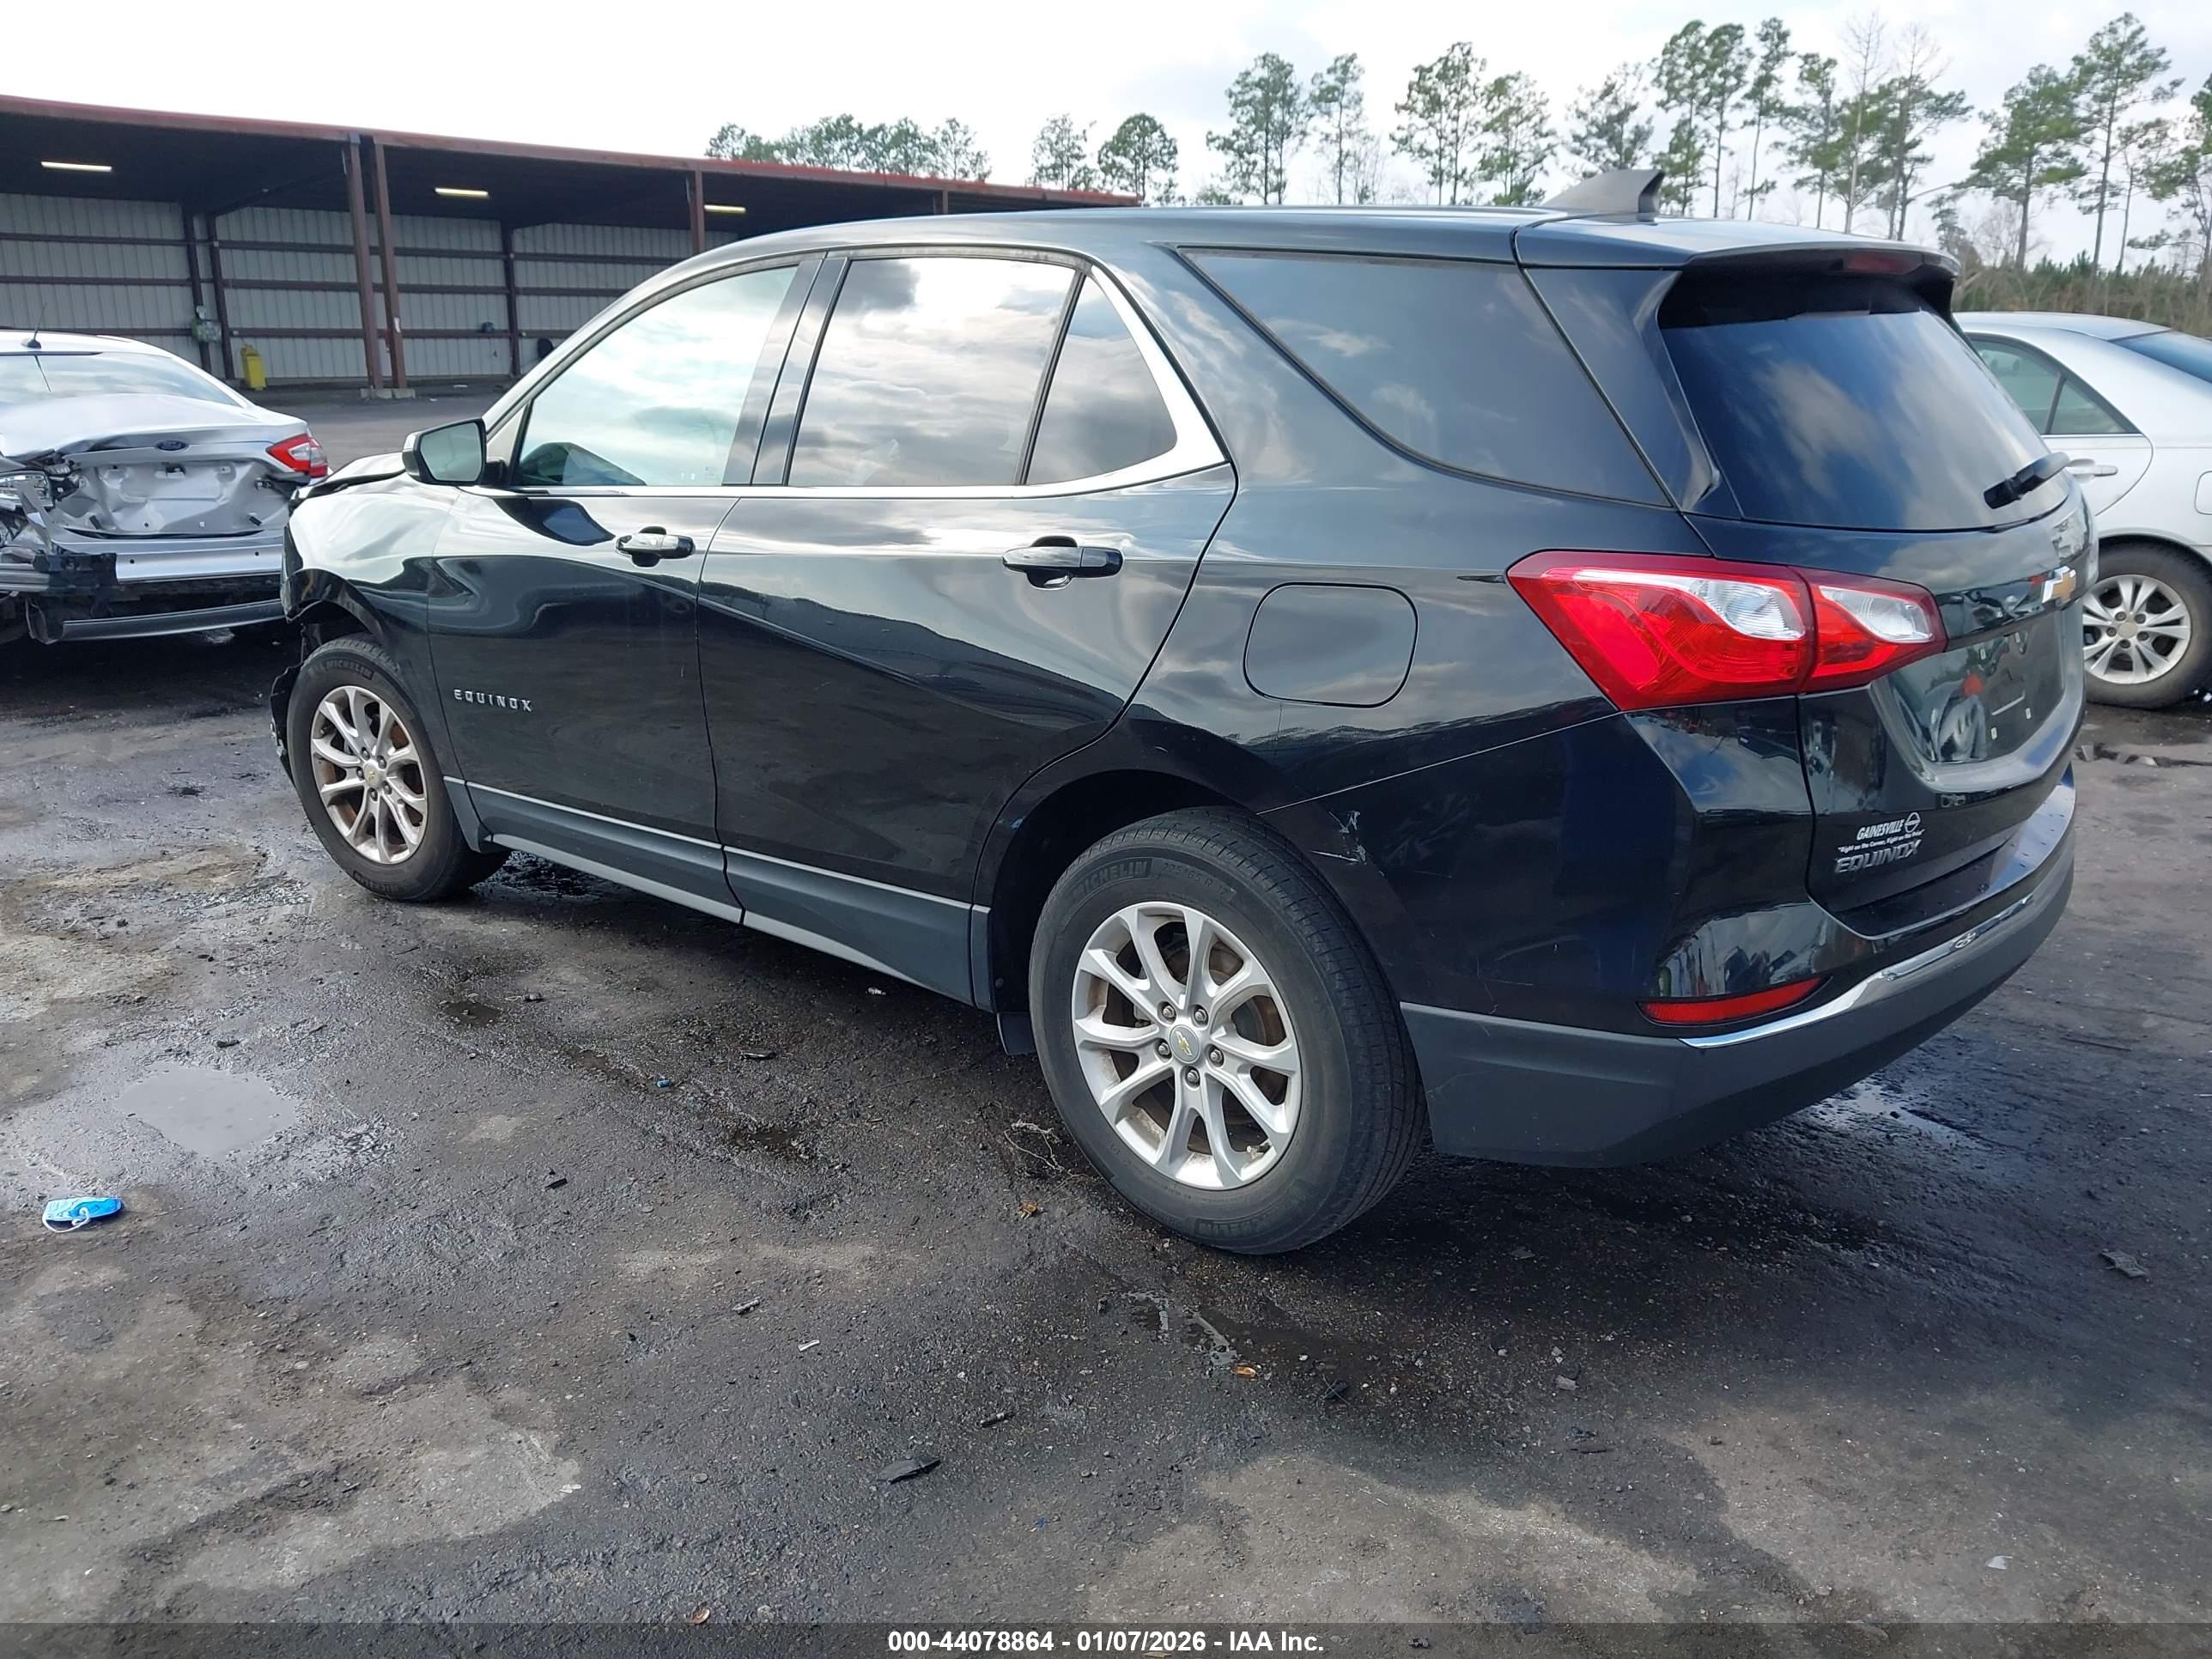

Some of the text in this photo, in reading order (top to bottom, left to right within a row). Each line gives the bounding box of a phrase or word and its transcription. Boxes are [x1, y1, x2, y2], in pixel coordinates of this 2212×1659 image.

[453, 689, 532, 712] EQUINOX
[1856, 818, 1905, 841] GAINESVILLE
[1835, 839, 1922, 873] EQUINOX
[1073, 861, 1148, 895] MICHELIN
